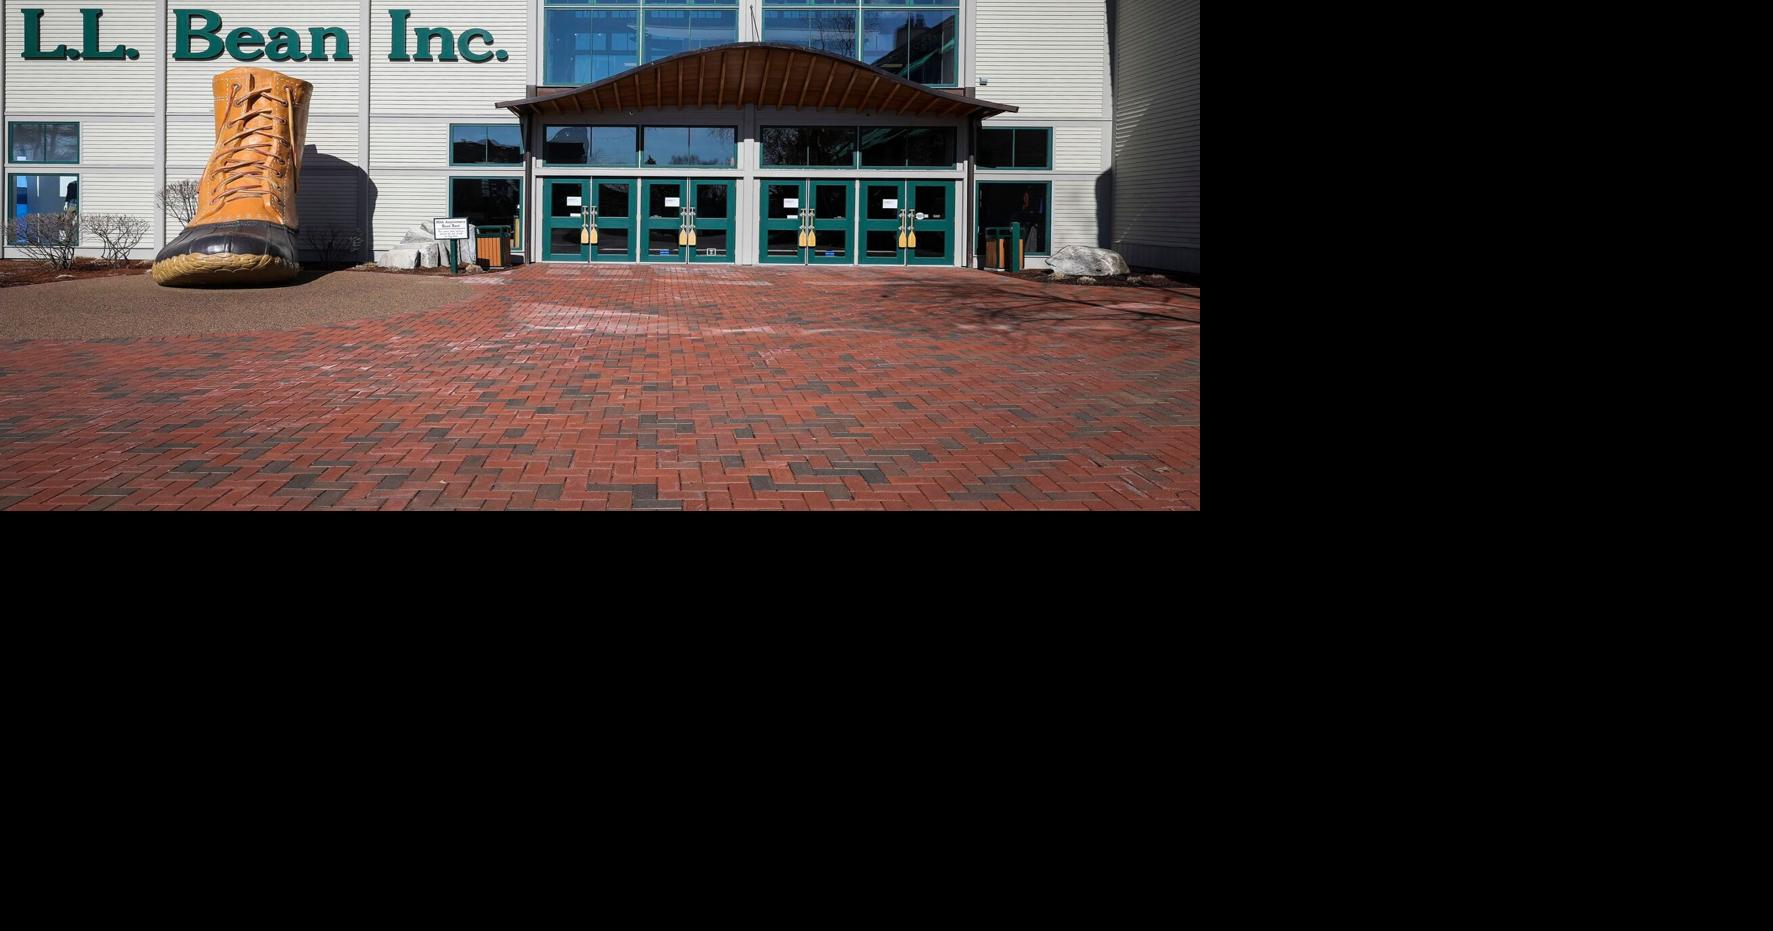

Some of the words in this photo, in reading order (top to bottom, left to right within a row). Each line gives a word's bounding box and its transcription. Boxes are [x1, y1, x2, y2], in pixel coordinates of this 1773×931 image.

[21, 8, 139, 60] L.L.
[172, 8, 353, 61] Bean
[388, 8, 508, 62] Inc.
